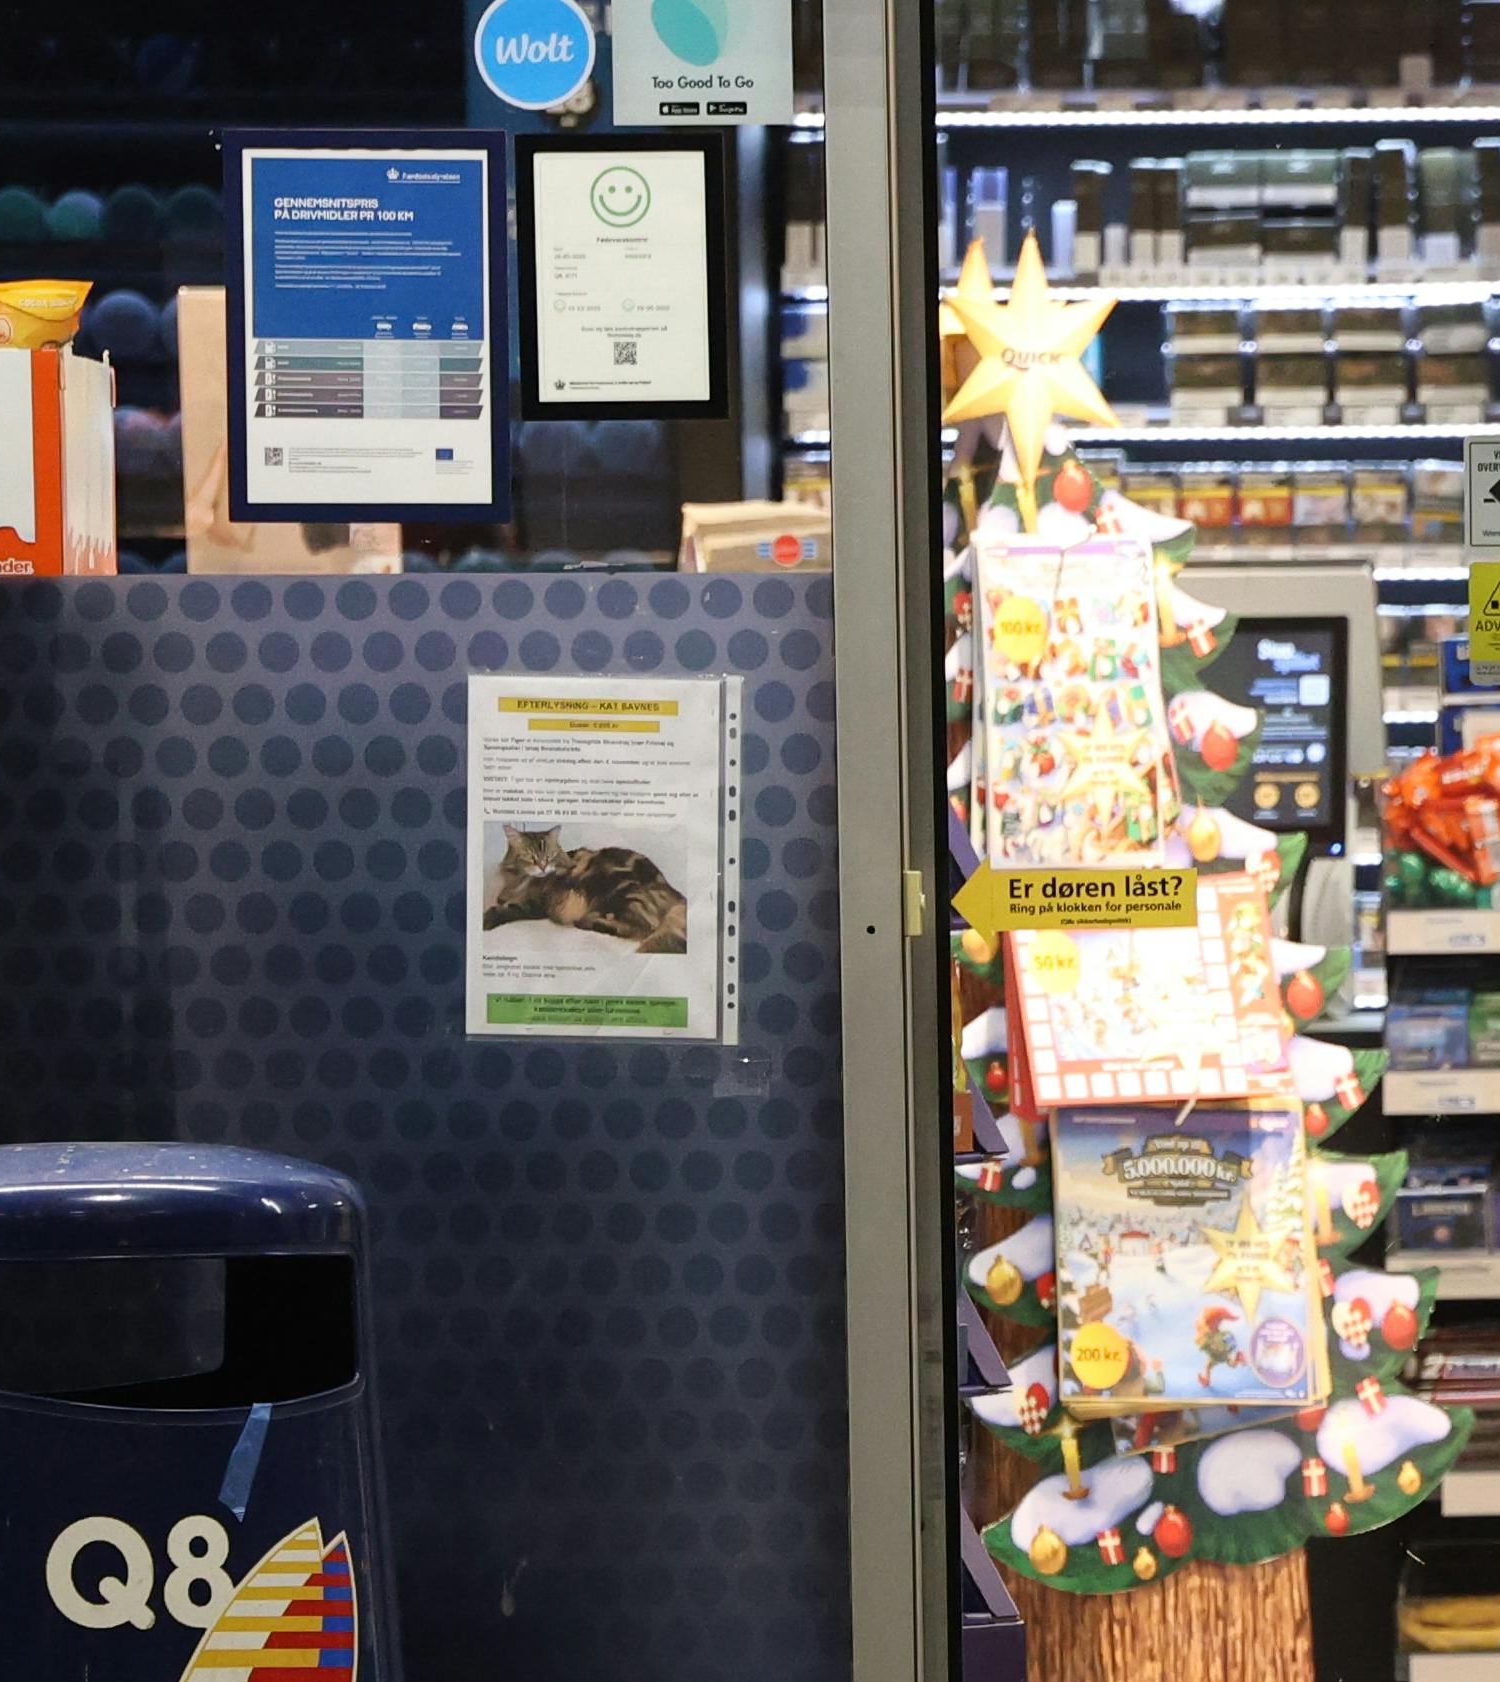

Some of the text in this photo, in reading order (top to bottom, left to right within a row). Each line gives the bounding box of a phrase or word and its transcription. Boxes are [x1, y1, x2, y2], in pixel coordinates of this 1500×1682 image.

[495, 32, 575, 65] Wolt
[652, 75, 754, 89] Too Good To Go
[274, 197, 379, 209] GENNEMSNITSPRIS
[274, 207, 414, 222] PÅ DRIVMIDLER PR 100 KM
[517, 700, 589, 711] EFTERLYSNING
[1009, 874, 1183, 899] Er døren låst?
[1009, 900, 1182, 916] Ring på klokken for personale
[1123, 1156, 1216, 1180] 5.000.000
[1076, 1348, 1100, 1361] 200
[46, 1515, 236, 1630] Q8
